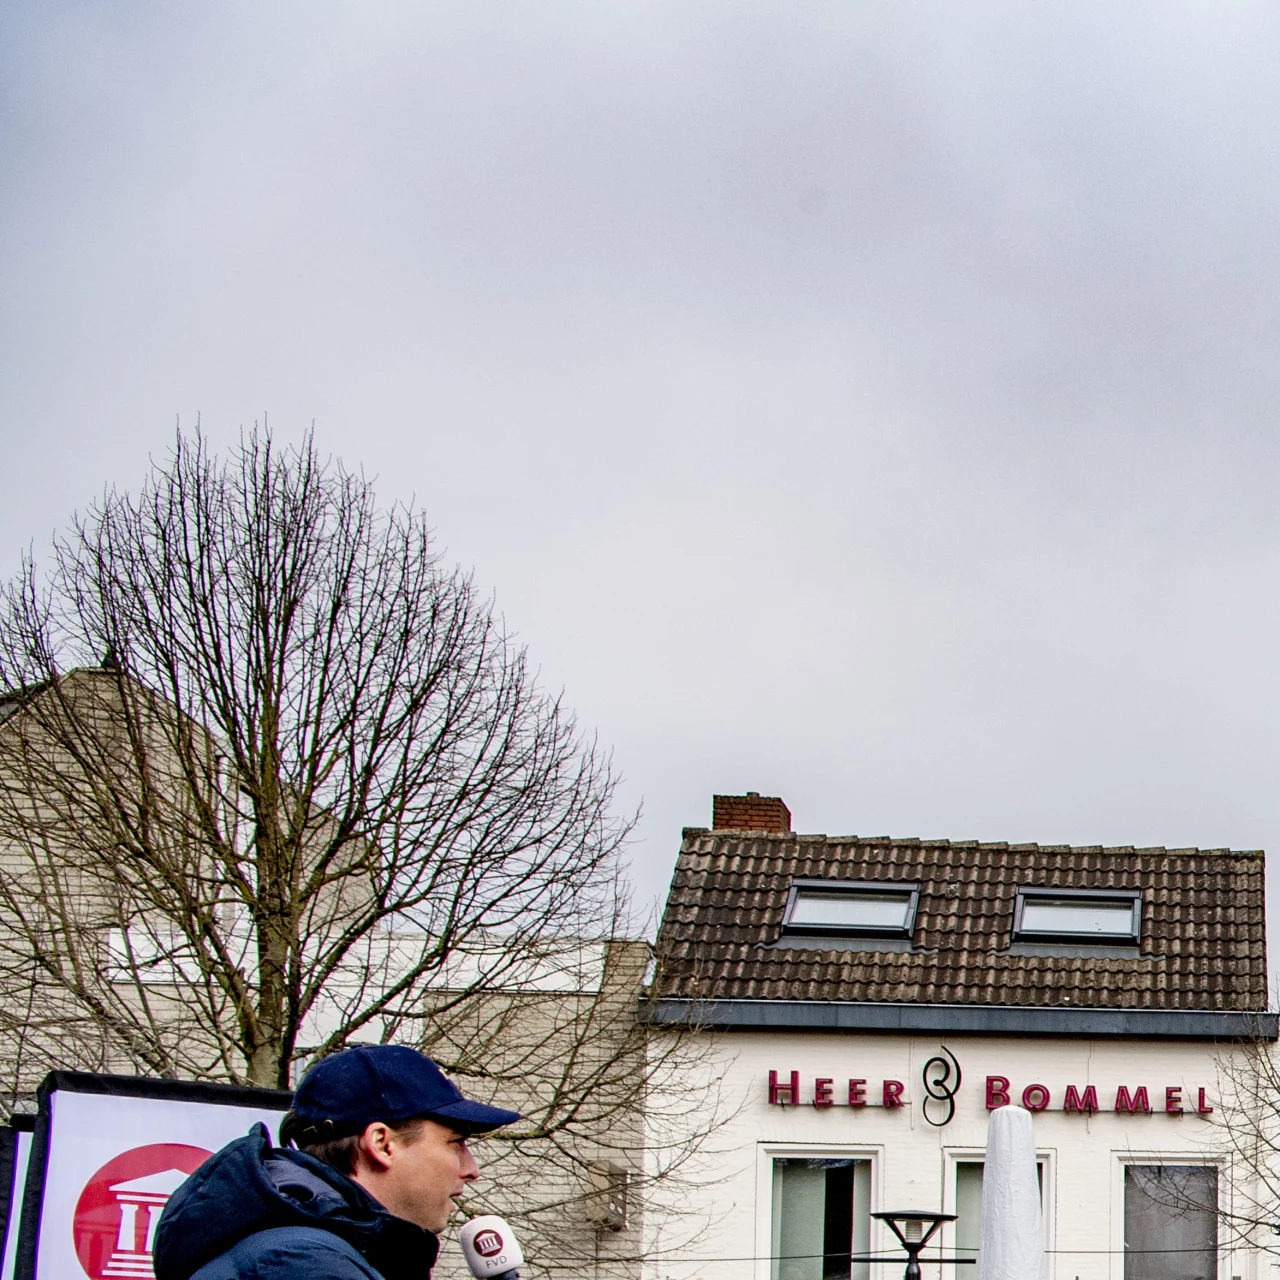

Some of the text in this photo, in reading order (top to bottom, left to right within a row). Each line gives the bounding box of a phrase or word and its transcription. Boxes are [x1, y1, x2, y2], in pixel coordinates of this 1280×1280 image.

[768, 1069, 1215, 1114] HEER BOMMEL
[485, 1255, 507, 1269] FVD
